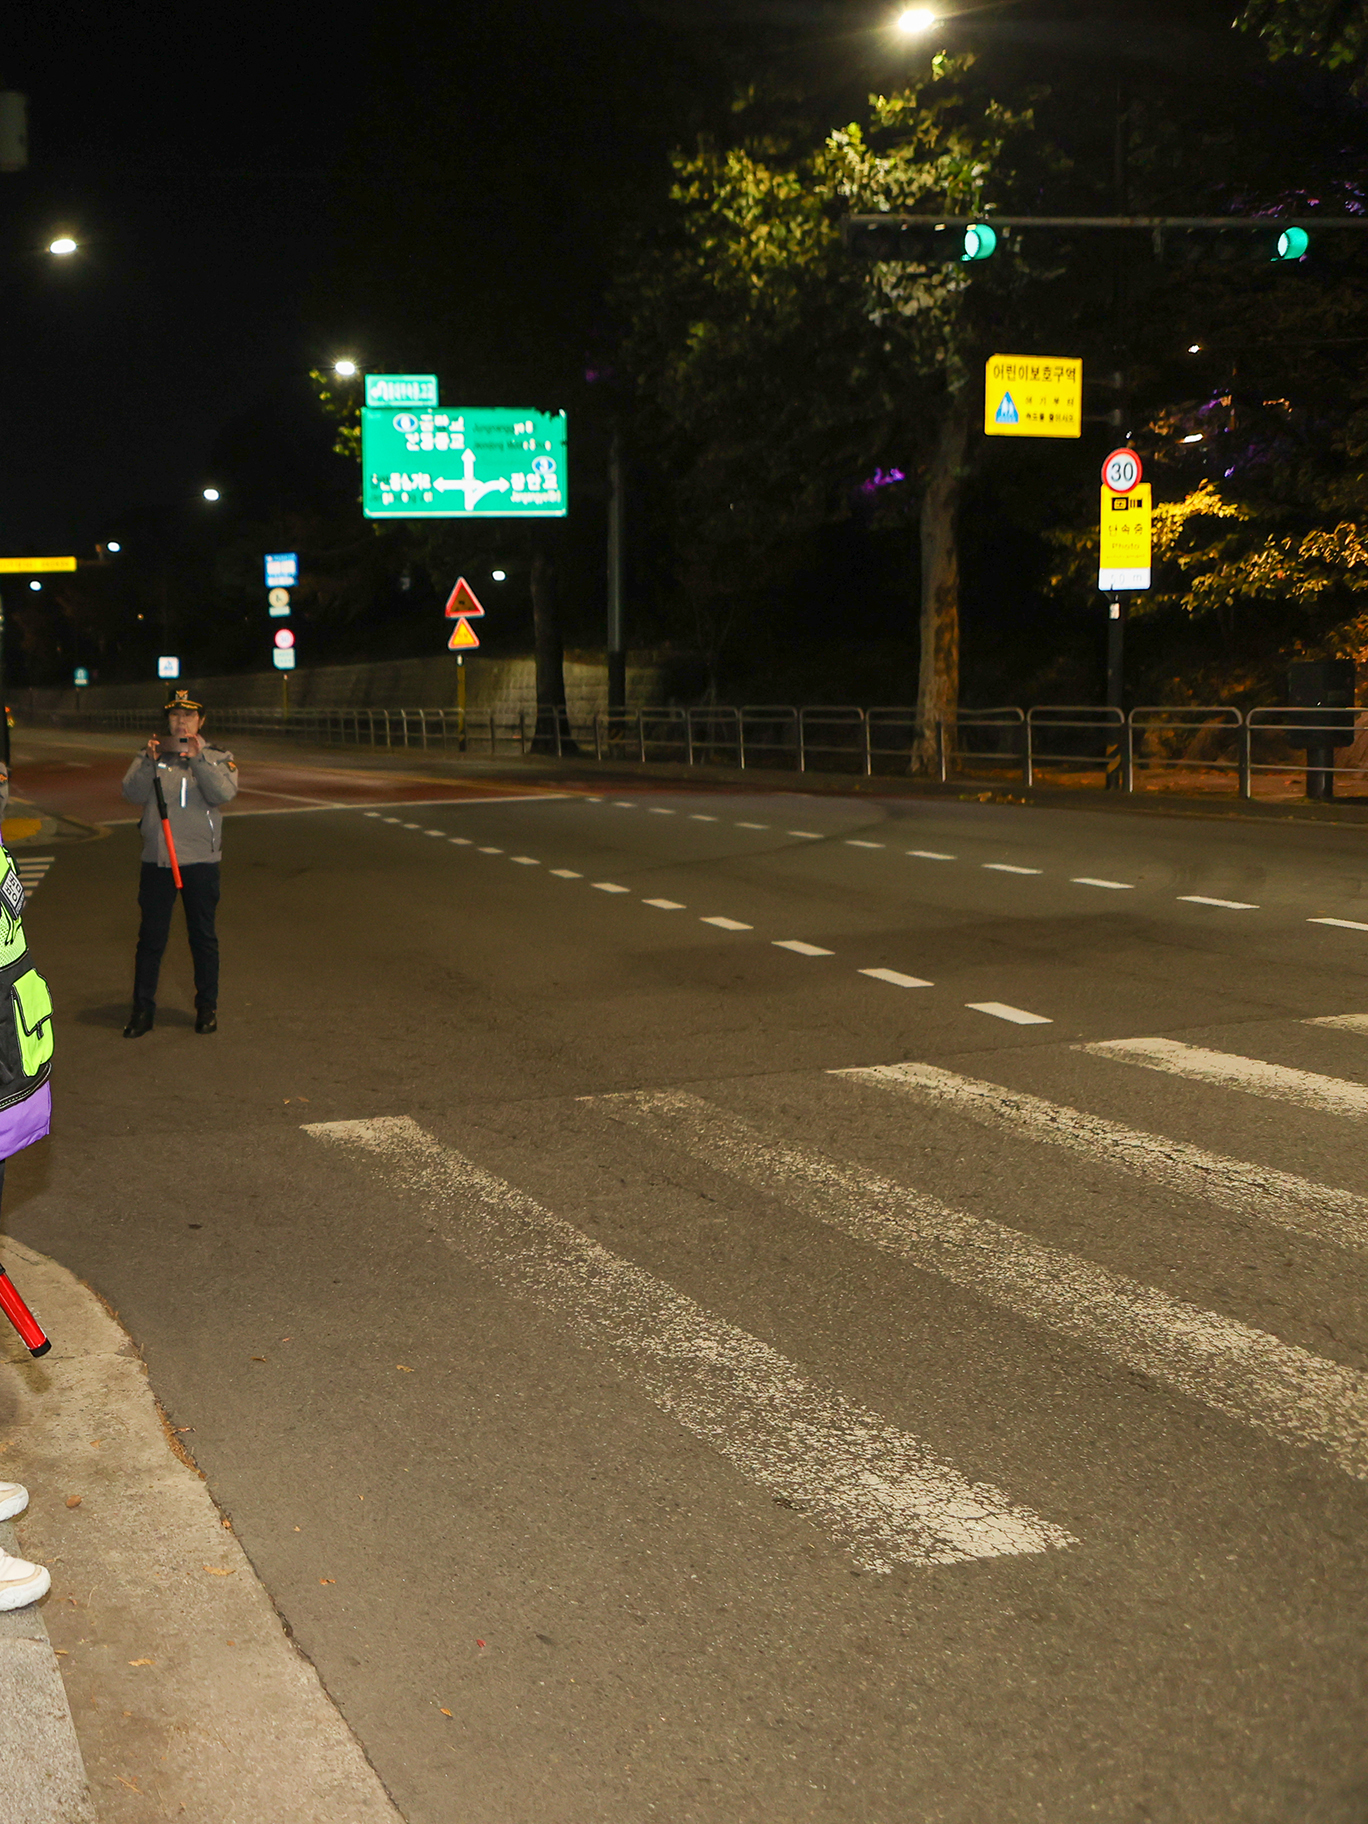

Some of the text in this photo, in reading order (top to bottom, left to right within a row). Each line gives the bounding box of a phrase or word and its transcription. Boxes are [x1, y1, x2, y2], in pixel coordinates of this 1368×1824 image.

[993, 364, 1076, 384] 어린이보호구역
[1111, 462, 1133, 482] 30
[4, 873, 21, 902] 방범
